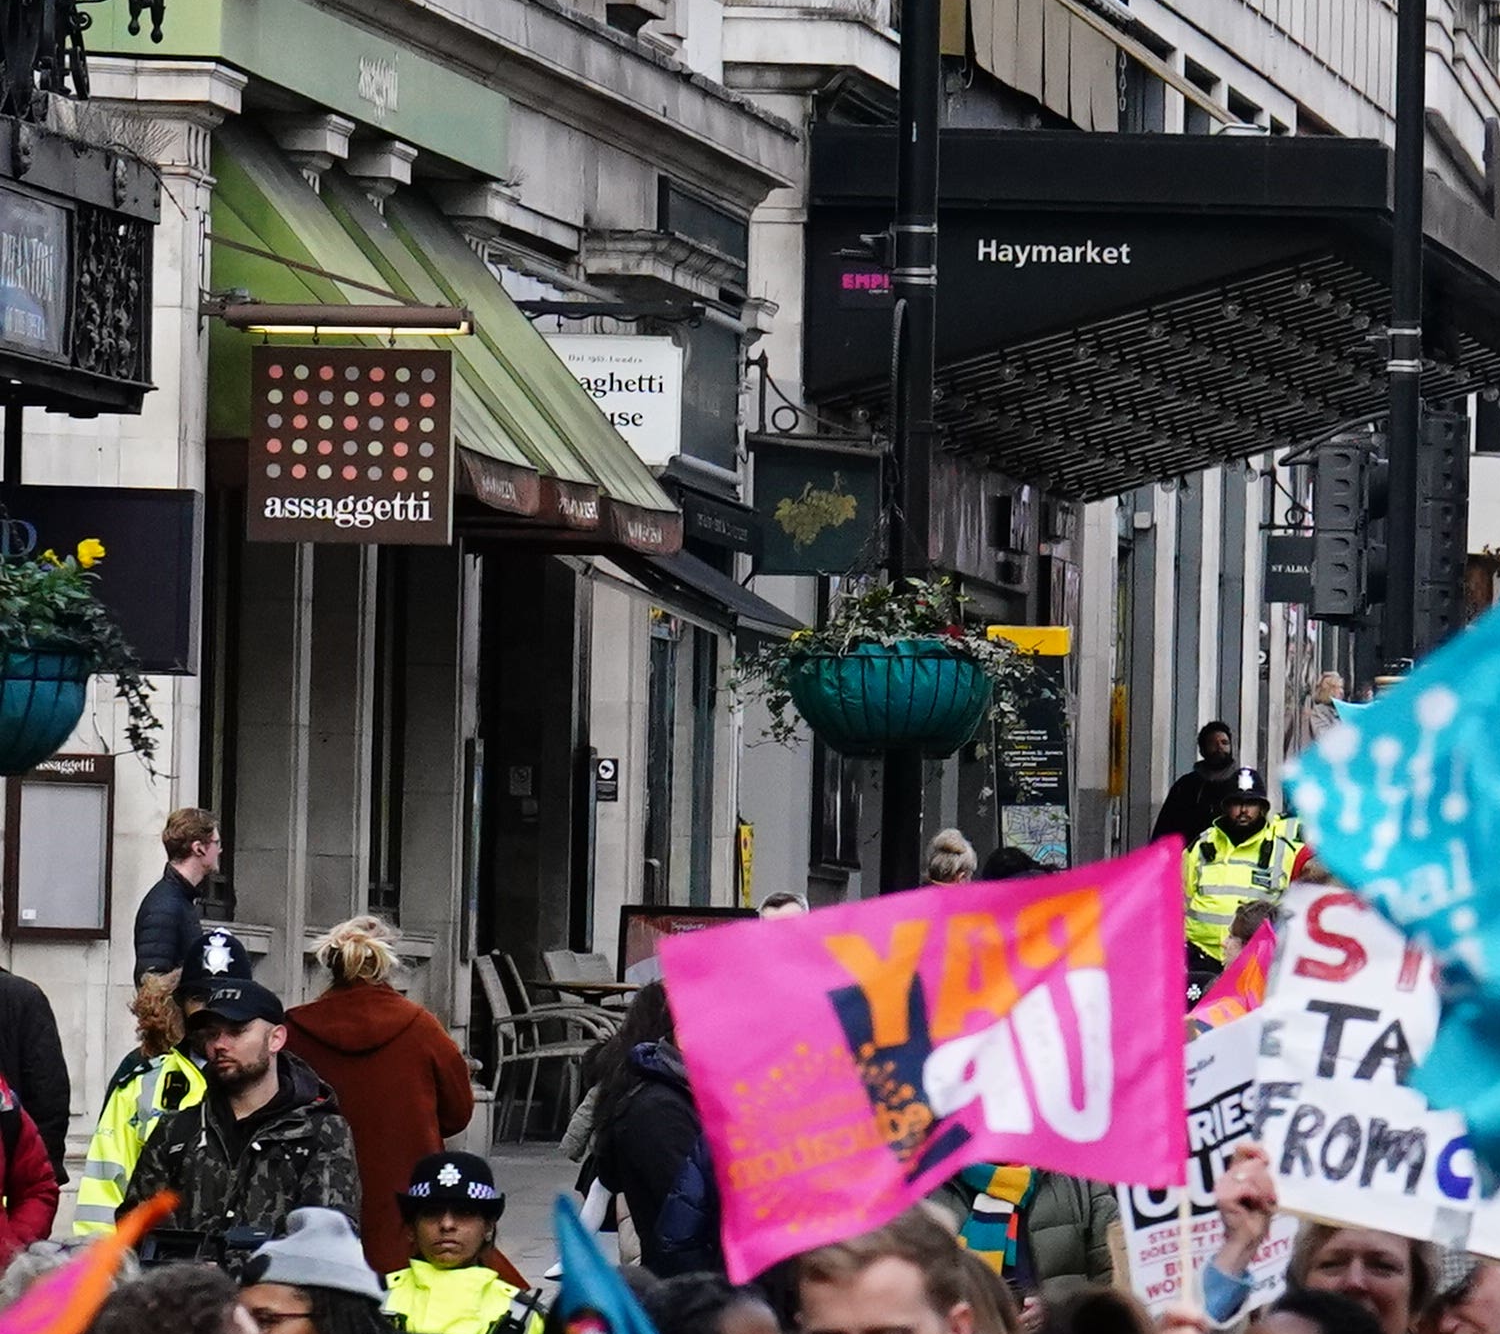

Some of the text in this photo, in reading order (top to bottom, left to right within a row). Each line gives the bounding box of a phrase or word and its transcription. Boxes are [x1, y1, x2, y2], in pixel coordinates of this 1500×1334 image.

[977, 239, 1131, 269] Haymarket
[841, 272, 893, 290] EMPI
[580, 373, 664, 398] aghetti
[263, 489, 432, 530] assaggetti
[1286, 564, 1311, 573] ALBA
[1258, 1081, 1426, 1195] FROM
